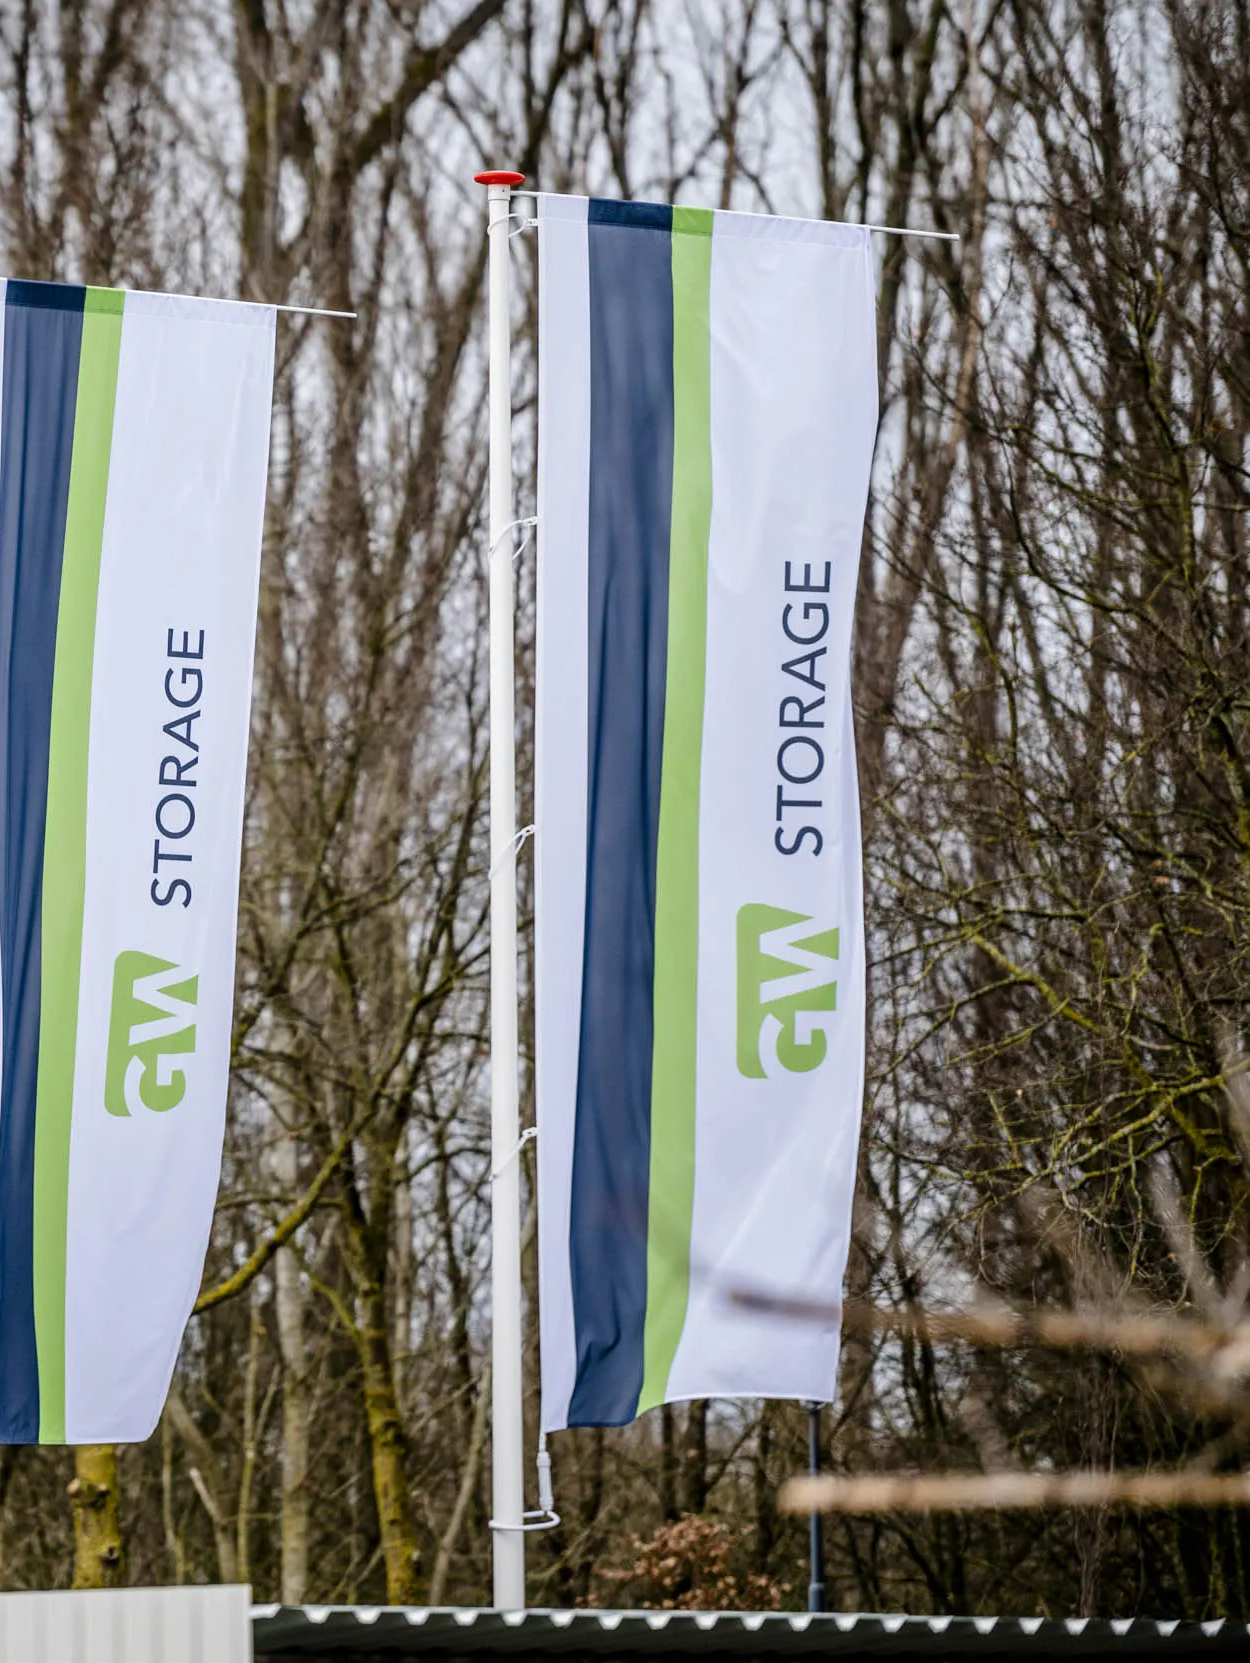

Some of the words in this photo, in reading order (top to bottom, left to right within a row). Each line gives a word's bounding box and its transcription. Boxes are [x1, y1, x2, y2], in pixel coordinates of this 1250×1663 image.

[151, 628, 205, 909] STORAGE
[774, 560, 832, 857] STORAGE
[104, 950, 199, 1118] GW
[736, 903, 840, 1079] GW
